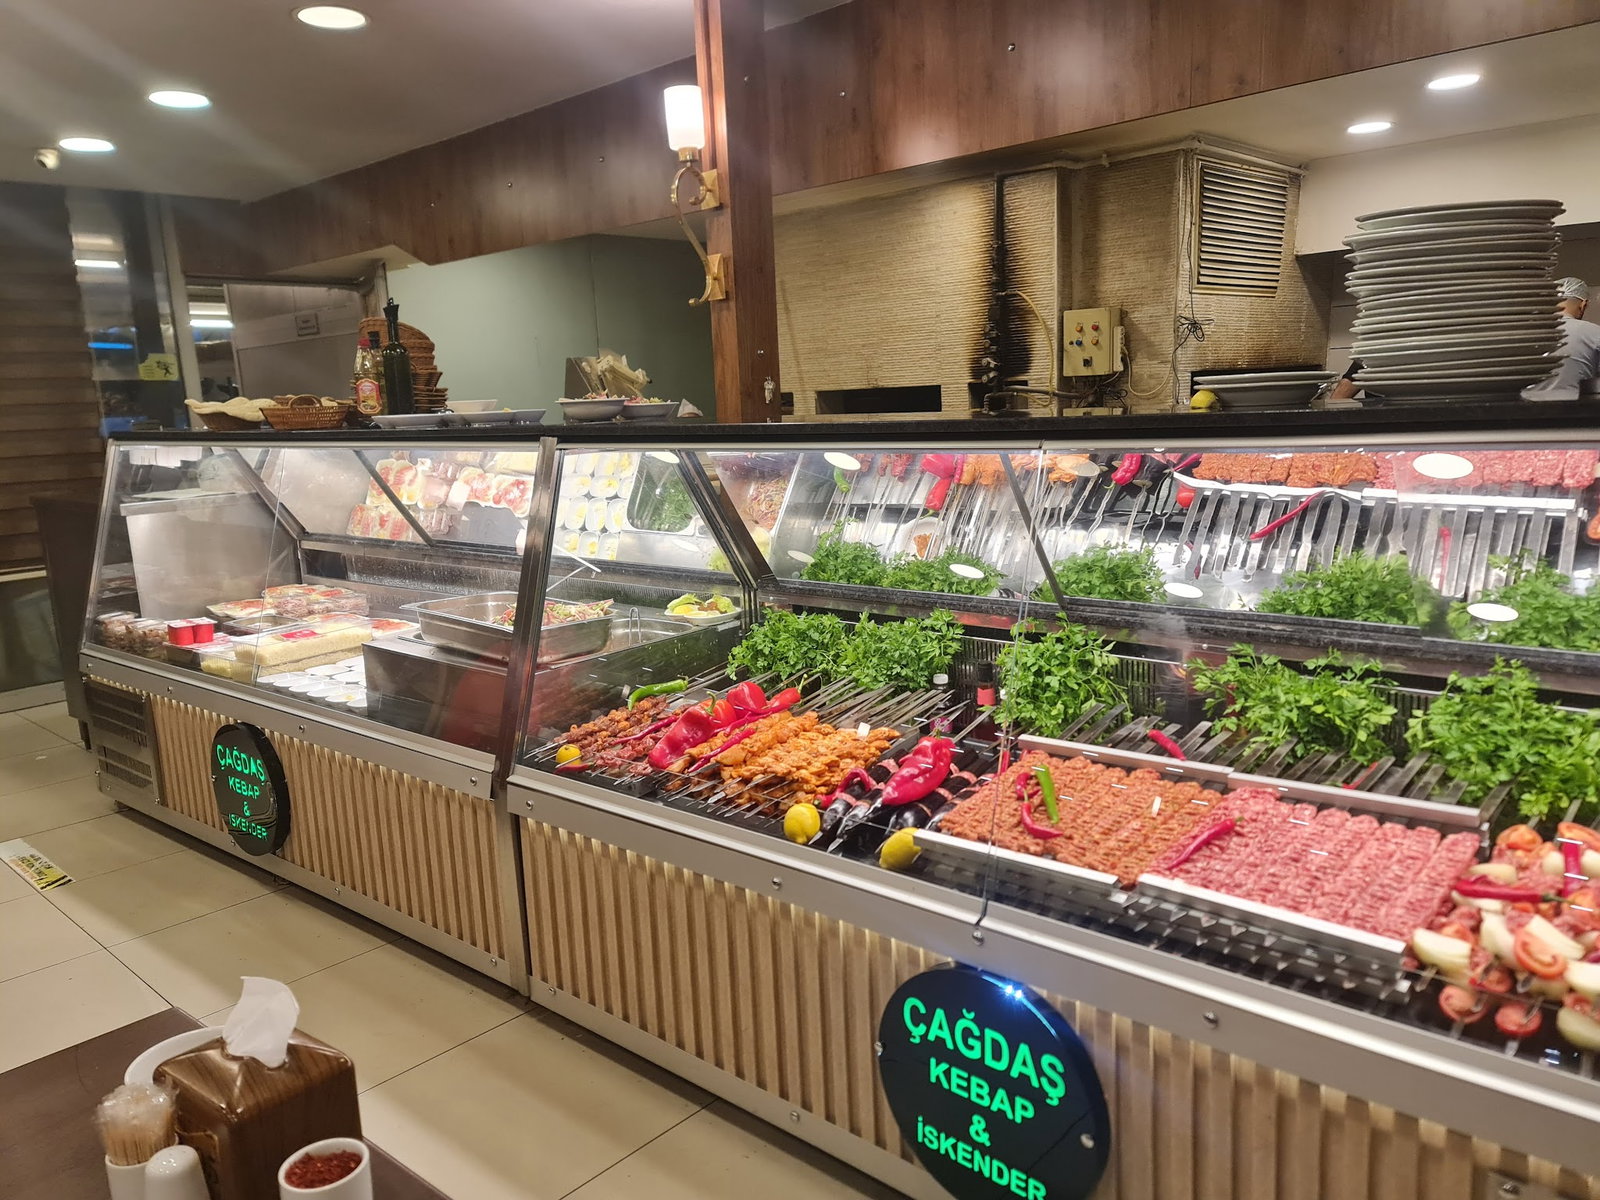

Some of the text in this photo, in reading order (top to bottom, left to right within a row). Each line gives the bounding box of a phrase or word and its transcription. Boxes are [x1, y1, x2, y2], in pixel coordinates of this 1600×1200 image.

[216, 744, 266, 786] ÇAĞDAŞ
[228, 775, 261, 800] KEBAP
[242, 801, 251, 817] &
[903, 997, 1067, 1107] ÇAĞDAŞ
[929, 1057, 1035, 1124] KEBAP
[969, 1114, 991, 1147] &
[917, 1116, 1047, 1200] İSKENDER
